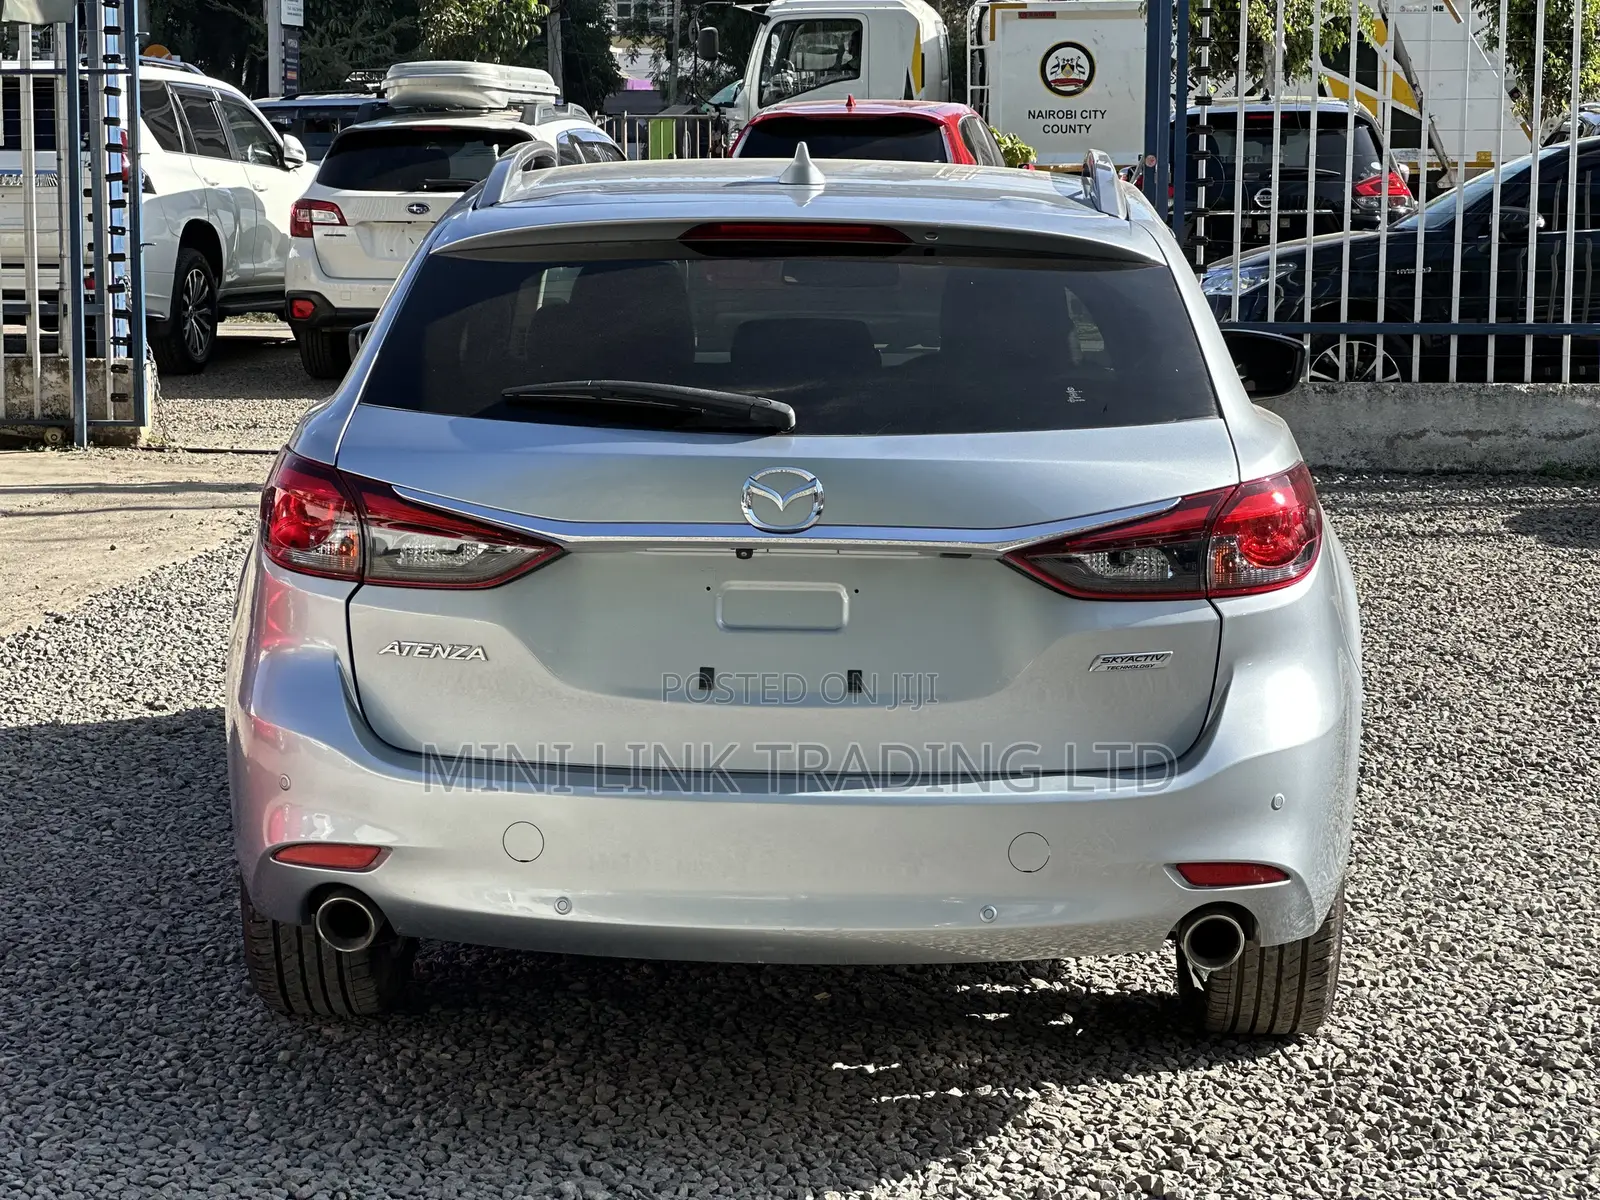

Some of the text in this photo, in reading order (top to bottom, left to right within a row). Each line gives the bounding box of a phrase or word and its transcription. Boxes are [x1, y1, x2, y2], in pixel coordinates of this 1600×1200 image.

[1027, 109, 1107, 120] NAIROBI CITY
[1042, 124, 1092, 134] COUNTY
[378, 640, 488, 661] ATENZA
[1101, 653, 1165, 664] SKYACTIV
[1106, 663, 1155, 671] TECHNOLOGY
